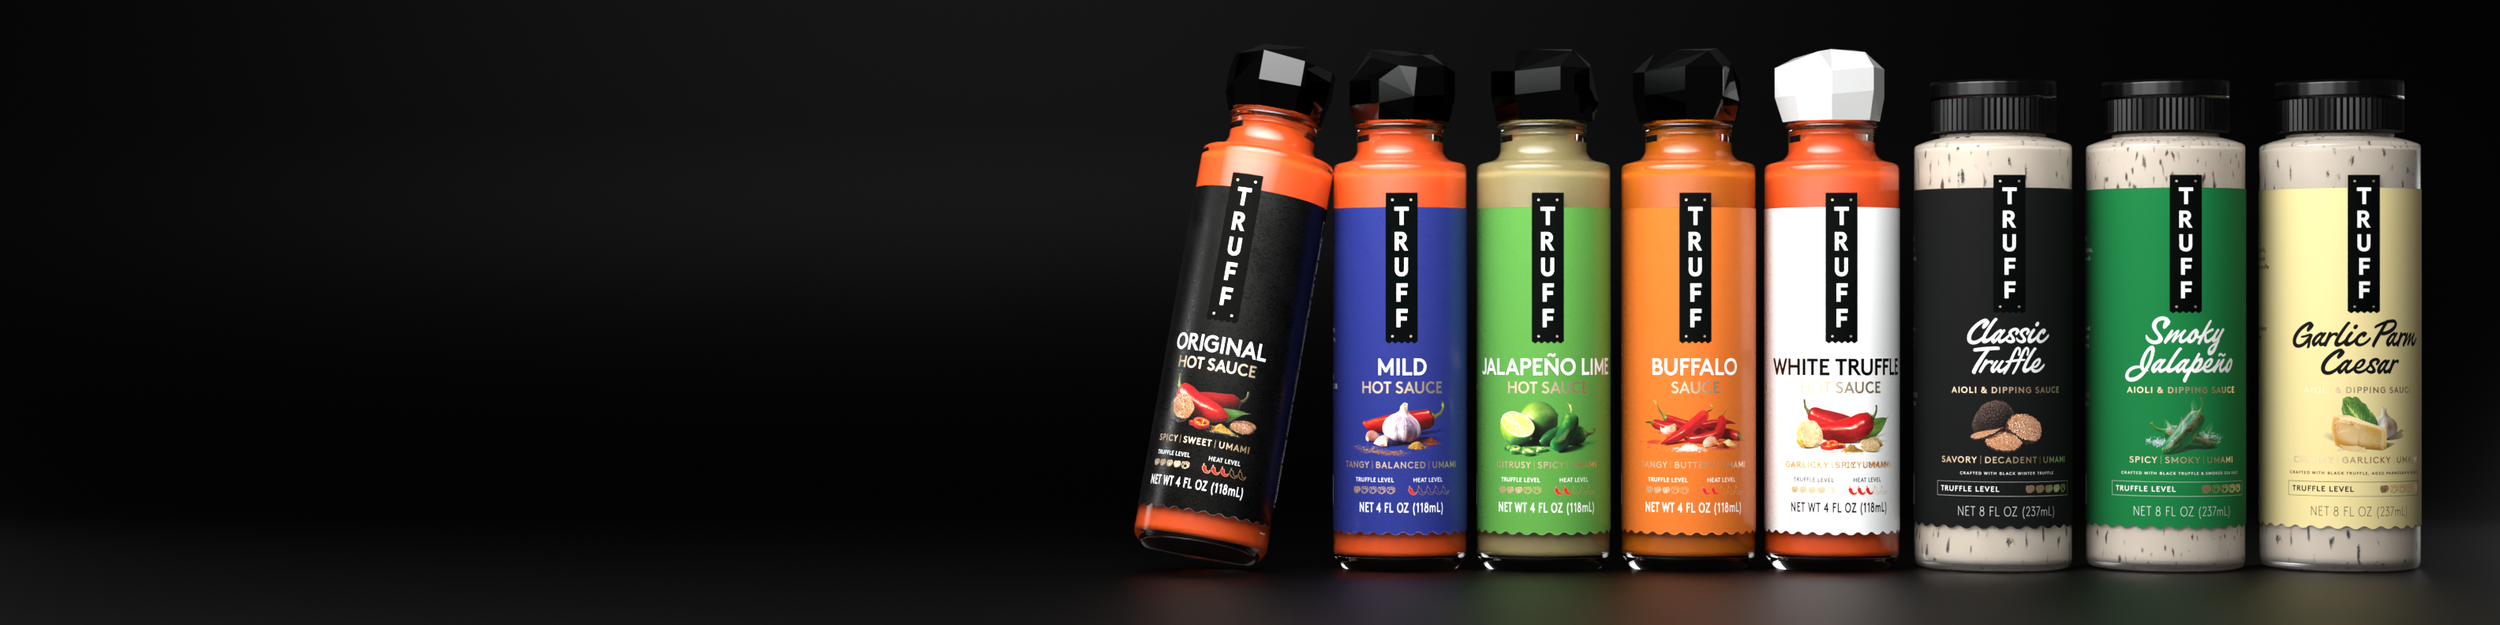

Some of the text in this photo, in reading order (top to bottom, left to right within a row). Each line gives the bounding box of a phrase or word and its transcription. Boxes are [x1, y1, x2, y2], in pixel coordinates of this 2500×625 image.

[1219, 186, 1253, 306] TRUFF
[2002, 187, 2017, 299] TRUFF
[2178, 187, 2194, 299] TRUFF
[2356, 187, 2372, 299] TRUFF
[1394, 206, 1410, 328] TRUFF
[1540, 206, 1556, 328] TRUFF
[1687, 206, 1703, 328] TRUFF
[1833, 206, 1850, 328] TRUFF
[1966, 317, 2049, 345] Classic
[2145, 316, 2225, 356] Smoky
[2292, 321, 2371, 349] Garlic
[2372, 319, 2417, 348] Parm
[1177, 331, 1267, 363] ORIGINAL
[1178, 354, 1257, 379] HOT SAUCE
[1378, 358, 1427, 376] MILD
[1482, 353, 1609, 376] JALAPEÑO LIME
[1652, 358, 1738, 376] BUFFALO
[1773, 358, 1899, 376] WHITE TRUFFLE
[1971, 346, 2045, 375] Truffle
[2125, 345, 2233, 383] Jalapeño
[2321, 348, 2399, 375] Caesar
[1362, 381, 1443, 394] HOT SAUCE
[1507, 381, 1588, 394] HOT SAUCE
[1671, 381, 1720, 394] SAUCE
[1800, 381, 1881, 394] HOT SAUCE
[1951, 386, 2059, 394] AIOLI & DIPPING SAUCE
[2126, 386, 2235, 394] AIOLI & DIPPING SAUCE
[1159, 433, 1250, 454] SPICY SWEET UMAMI
[1208, 455, 1241, 467] HEAT LEVEL
[1345, 460, 1370, 469] TANGY
[1376, 461, 1426, 469] BALANCED
[1496, 461, 1531, 469] CITRUSY
[1537, 461, 1564, 469] SPICY
[1641, 461, 1745, 469] TANGY BUTTERY UMAMI
[1785, 461, 1829, 469] GARLICKY
[1941, 455, 2066, 464] SAVORY DECADENT UMAMI
[2129, 456, 2233, 464] SPICY SMOKY UMAMI
[2294, 455, 2334, 463] CREAMY
[1150, 473, 1244, 501] NET WT 4 FL OZ (118mL)
[1975, 485, 2000, 493] LEVEL
[2115, 484, 2176, 493] TRUFFLE LEVEL
[2292, 484, 2354, 493] TRUFFLE LEVEL
[1359, 502, 1444, 516] NET 4 FL OZ (118mL)
[1498, 501, 1595, 515] NET WT 4 FL OZ (118mL)
[1645, 501, 1741, 515] NET WT 4 FL OZ (118mL)
[1790, 502, 1887, 515] NET WT 4 FL OZ (118mL)
[1957, 506, 2055, 519] NET 8 FL OZ (237mL)
[2133, 506, 2231, 519] NET 8 FL OZ (237mL)
[2310, 506, 2408, 519] NET 8 FL OZ (237mL)
